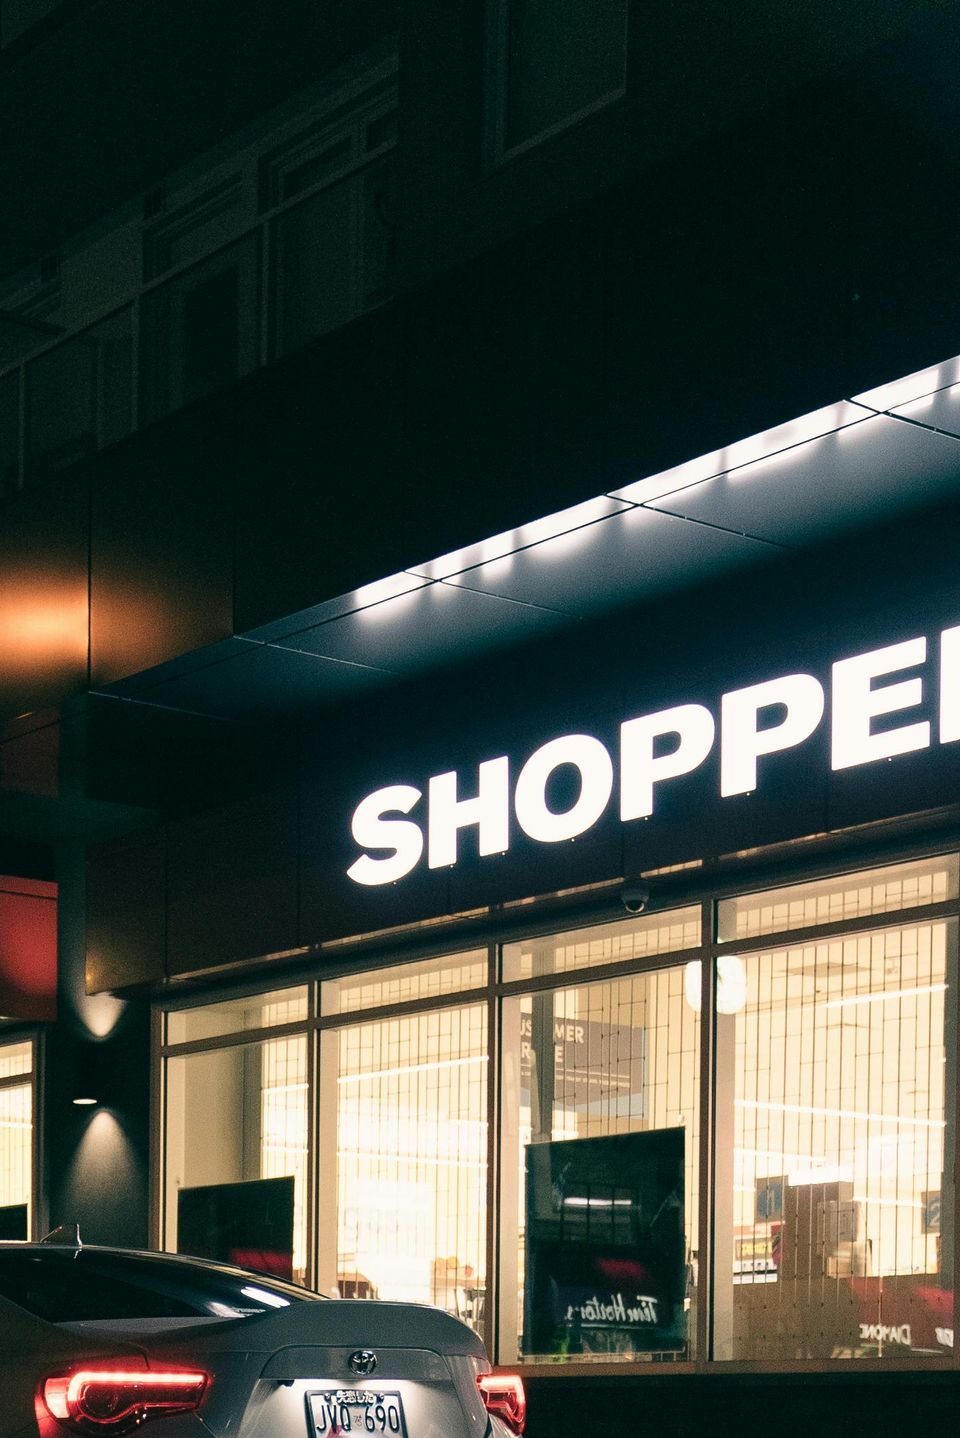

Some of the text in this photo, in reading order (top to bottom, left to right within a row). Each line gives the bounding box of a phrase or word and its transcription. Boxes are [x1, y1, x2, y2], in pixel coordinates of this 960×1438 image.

[346, 626, 960, 886] SHOPPE
[520, 1018, 585, 1044] USMER
[365, 1405, 400, 1433] 690
